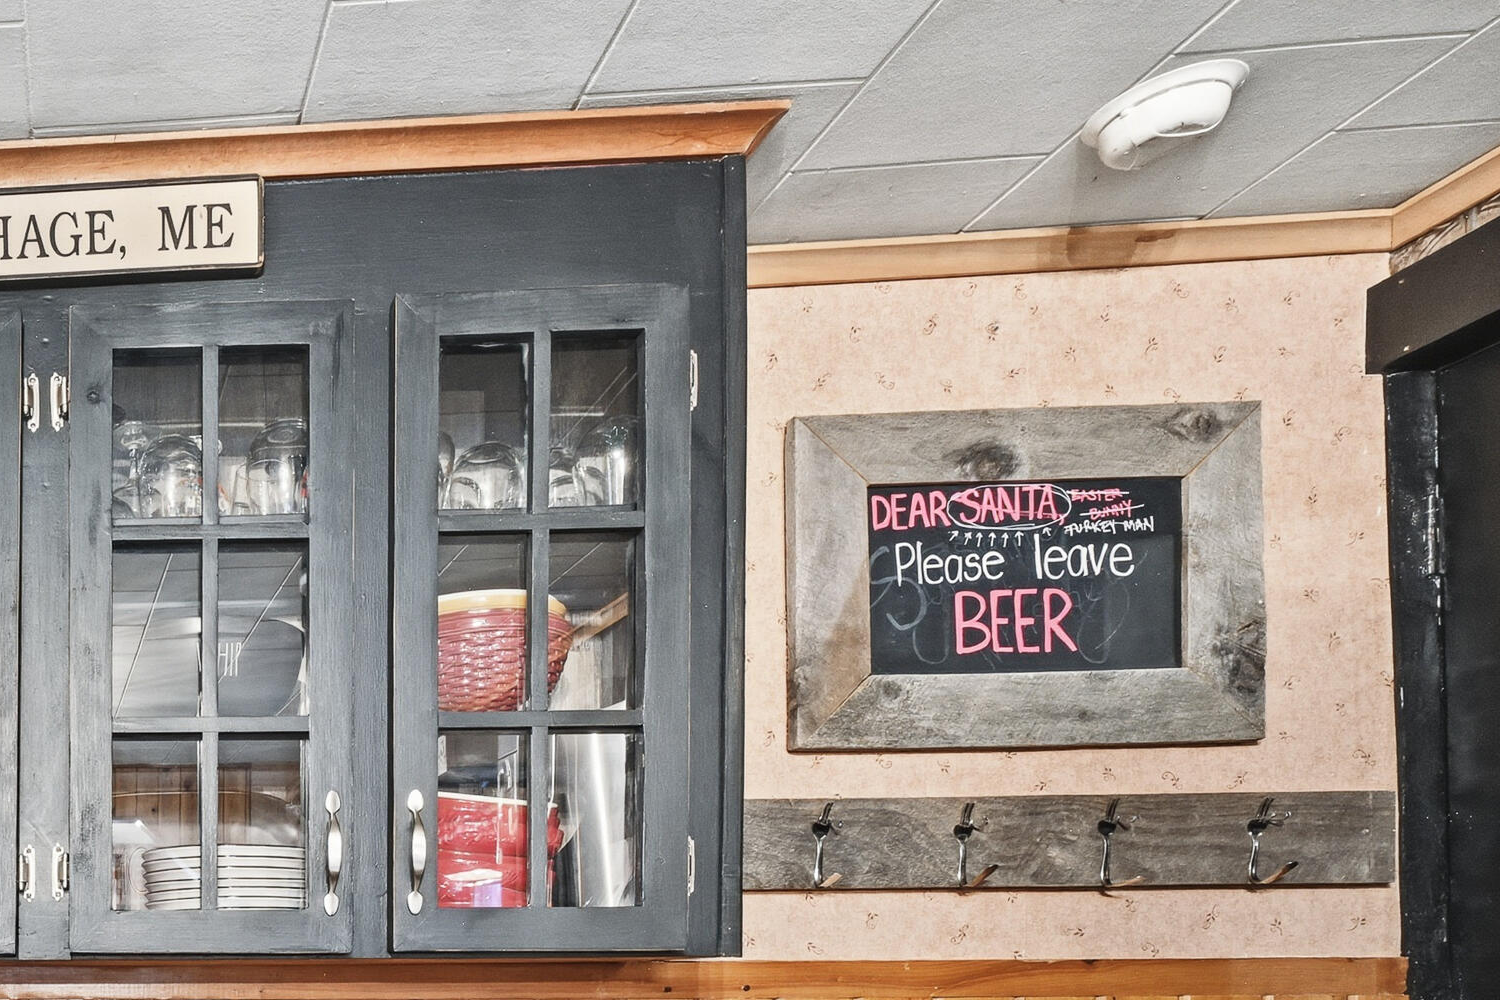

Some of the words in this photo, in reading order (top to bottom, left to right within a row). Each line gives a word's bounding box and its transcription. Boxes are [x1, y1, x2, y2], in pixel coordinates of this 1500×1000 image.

[157, 203, 235, 252] ME
[871, 490, 951, 531] DEAR
[1063, 519, 1117, 537] TURKEY
[1122, 515, 1155, 532] MAN
[895, 541, 1005, 587] Please
[1034, 533, 1135, 580] leave
[955, 588, 1078, 654] BEER
